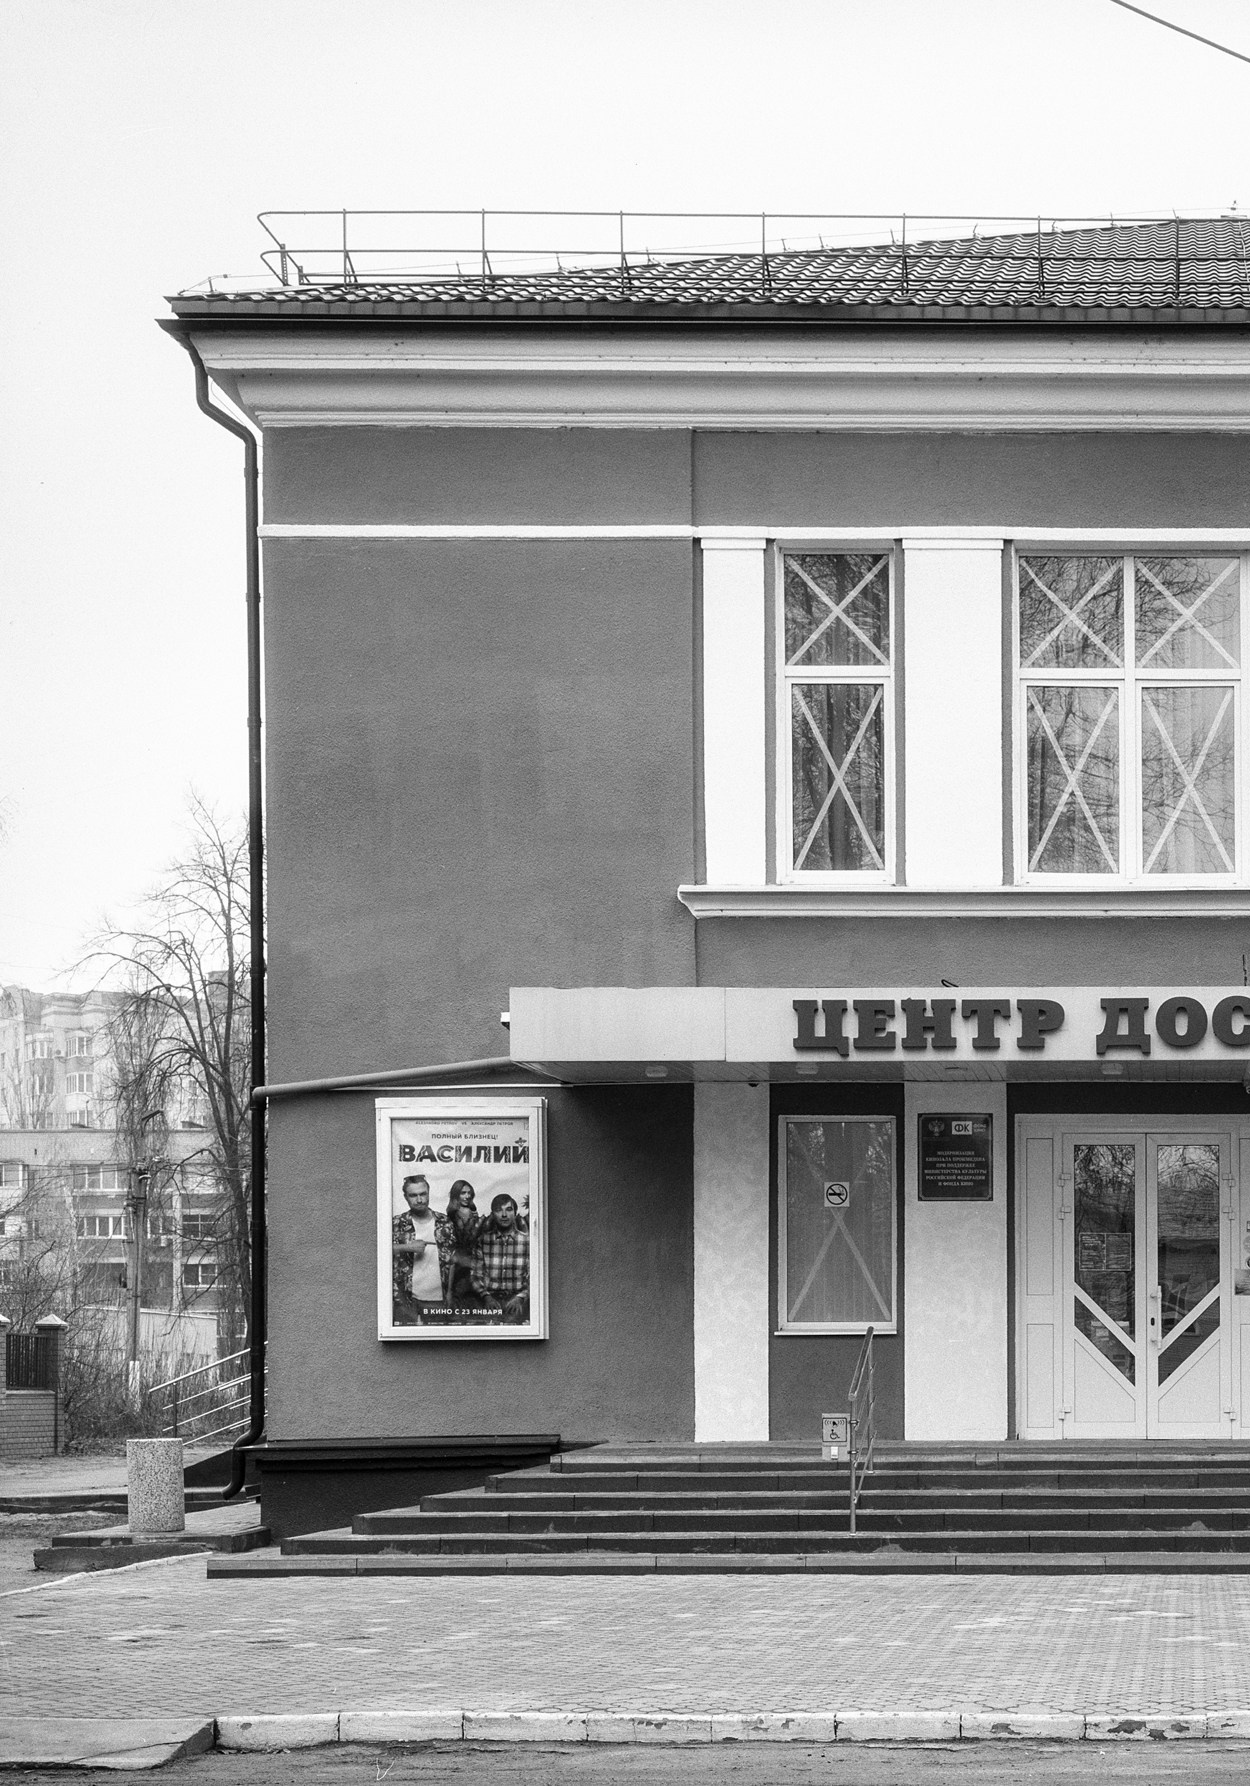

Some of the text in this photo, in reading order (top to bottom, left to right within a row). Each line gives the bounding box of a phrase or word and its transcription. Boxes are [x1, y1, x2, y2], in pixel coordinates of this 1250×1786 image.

[792, 999, 1065, 1057] ЦЕНТР
[954, 1123, 970, 1133] ФК
[399, 1138, 529, 1163] ВАСИЛИЙ
